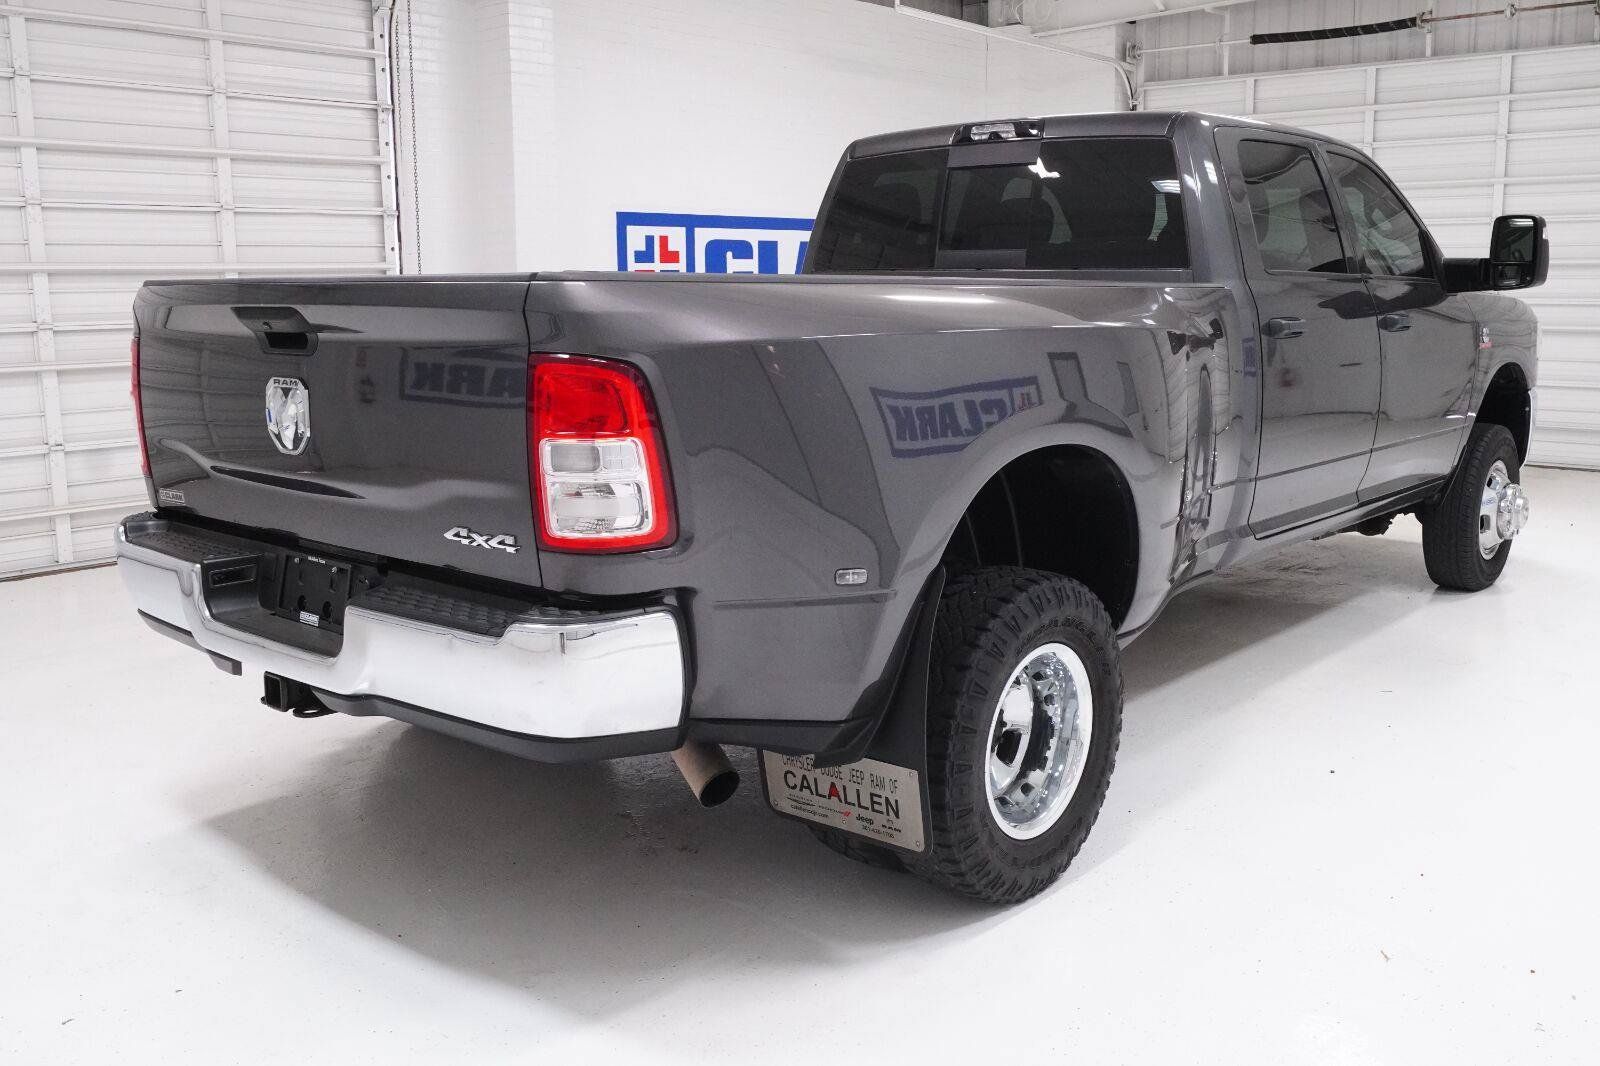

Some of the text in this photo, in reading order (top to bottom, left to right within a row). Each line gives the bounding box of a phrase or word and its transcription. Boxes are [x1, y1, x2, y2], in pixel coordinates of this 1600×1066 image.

[273, 379, 299, 387] RAM
[849, 768, 865, 785] JEEP
[869, 773, 885, 792] RAM
[889, 778, 898, 794] OF
[783, 770, 900, 819] CALALLEN
[856, 813, 874, 826] Jeep
